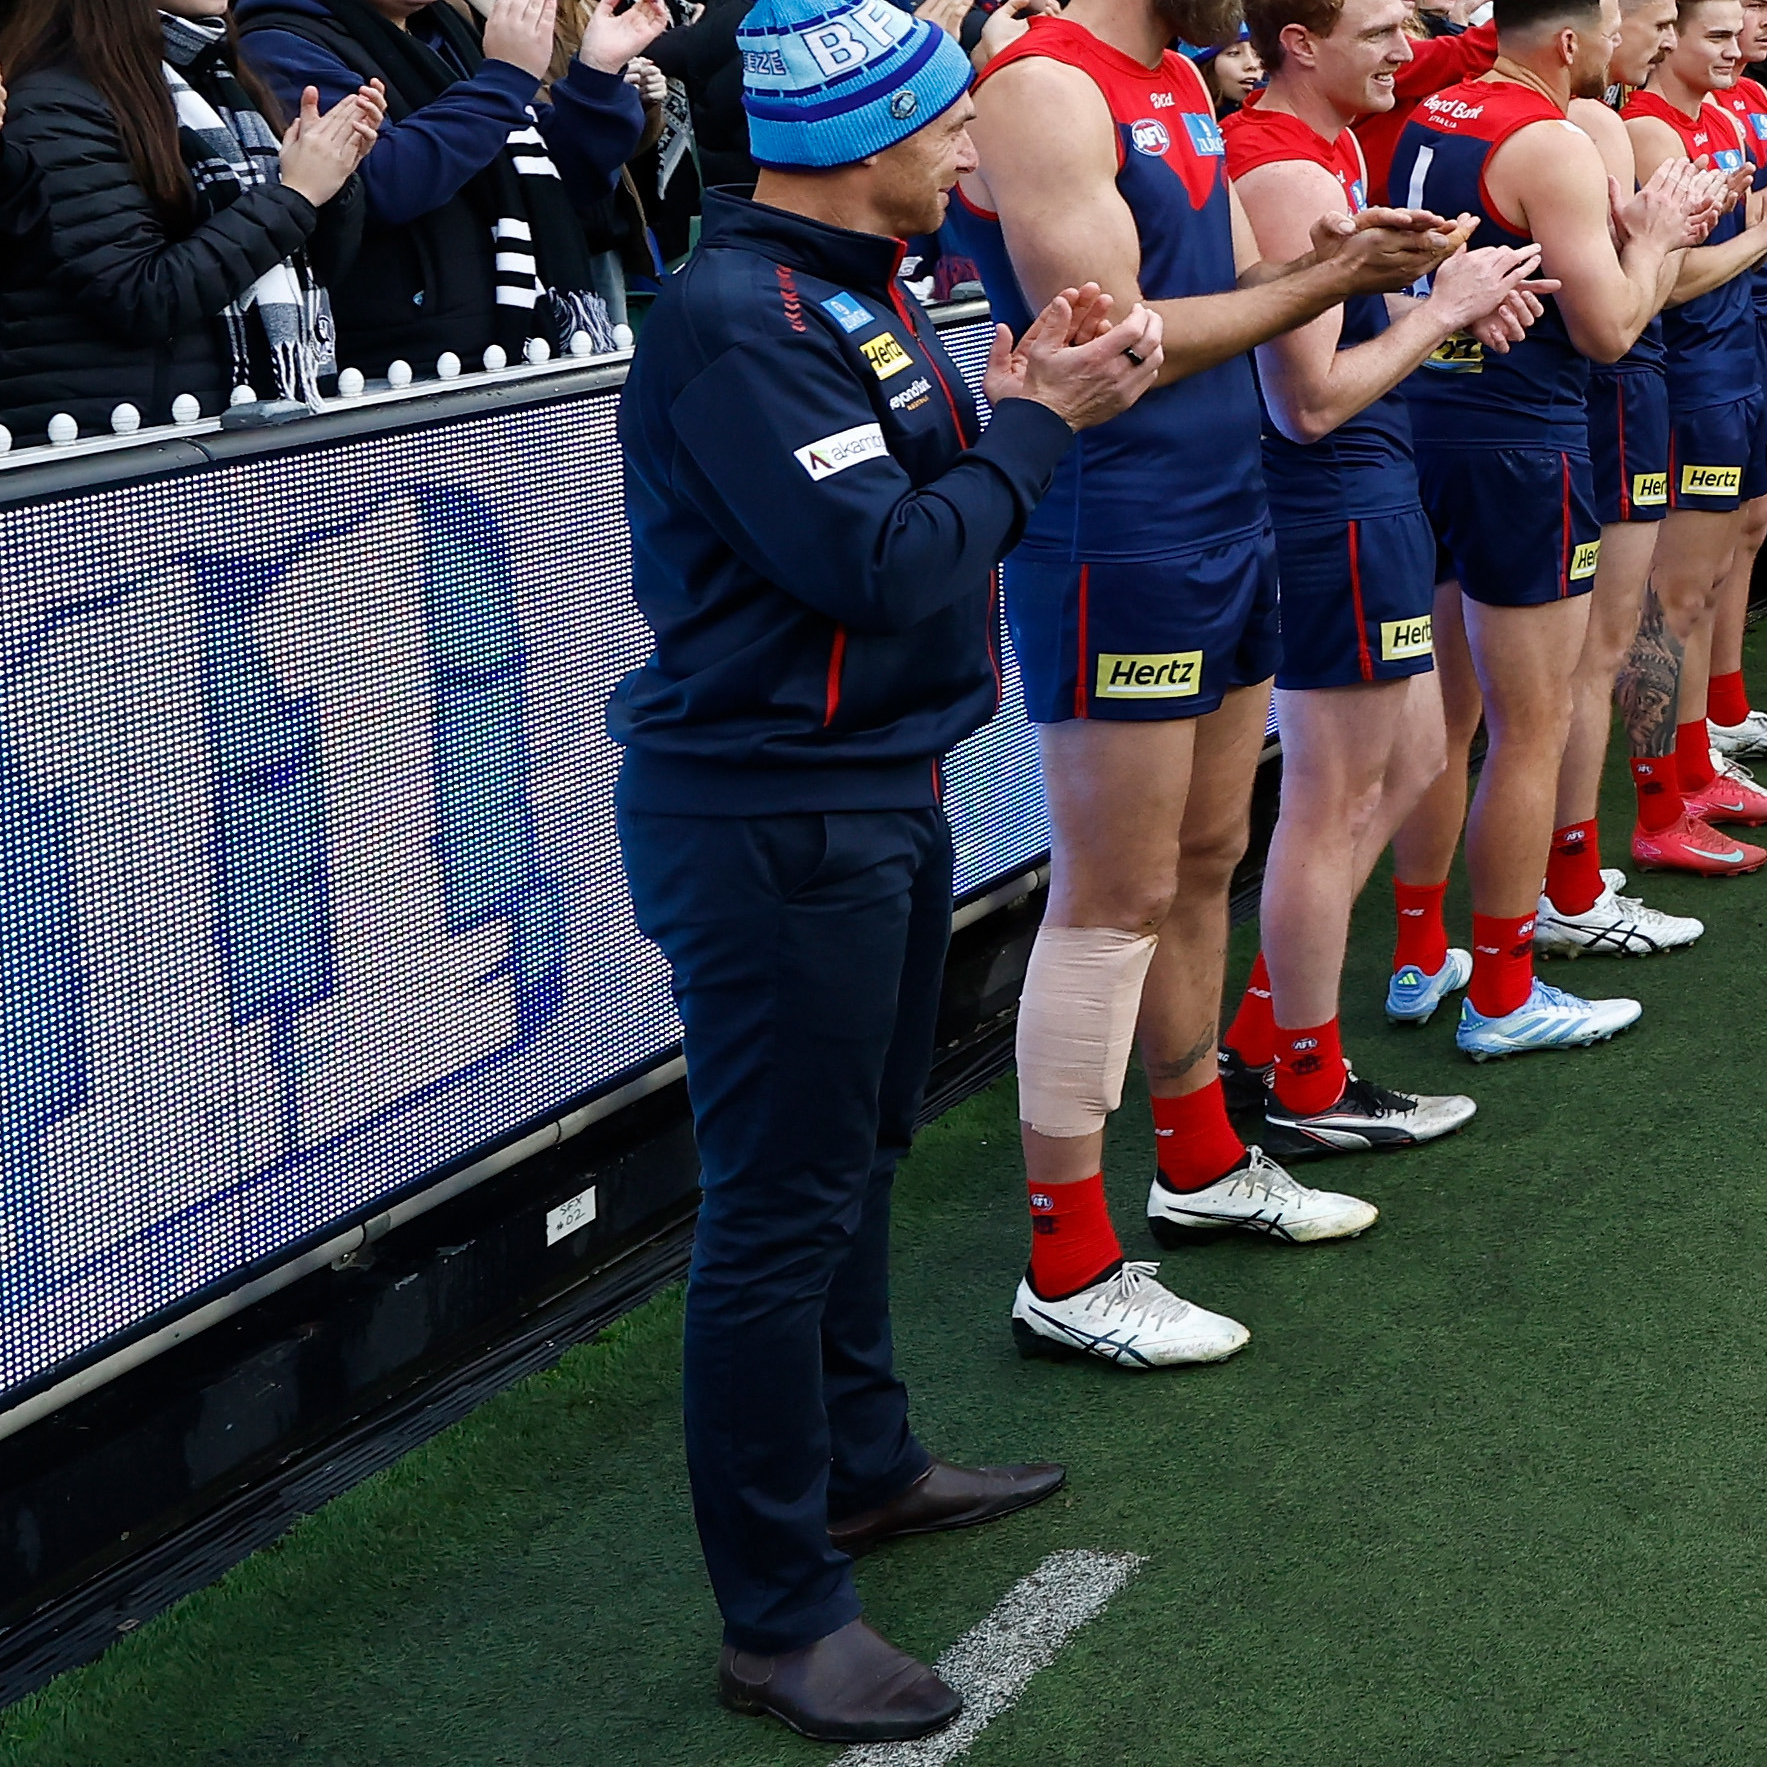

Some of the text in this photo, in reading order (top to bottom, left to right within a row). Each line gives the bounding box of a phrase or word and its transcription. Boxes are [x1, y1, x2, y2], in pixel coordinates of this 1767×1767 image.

[802, 1, 894, 78] BF
[1133, 124, 1168, 150] AFL
[863, 338, 905, 368] Hertz
[1689, 469, 1738, 489] Hertz
[1576, 546, 1600, 569] Her
[1108, 659, 1195, 688] Hertz
[559, 1195, 583, 1216] SFX
